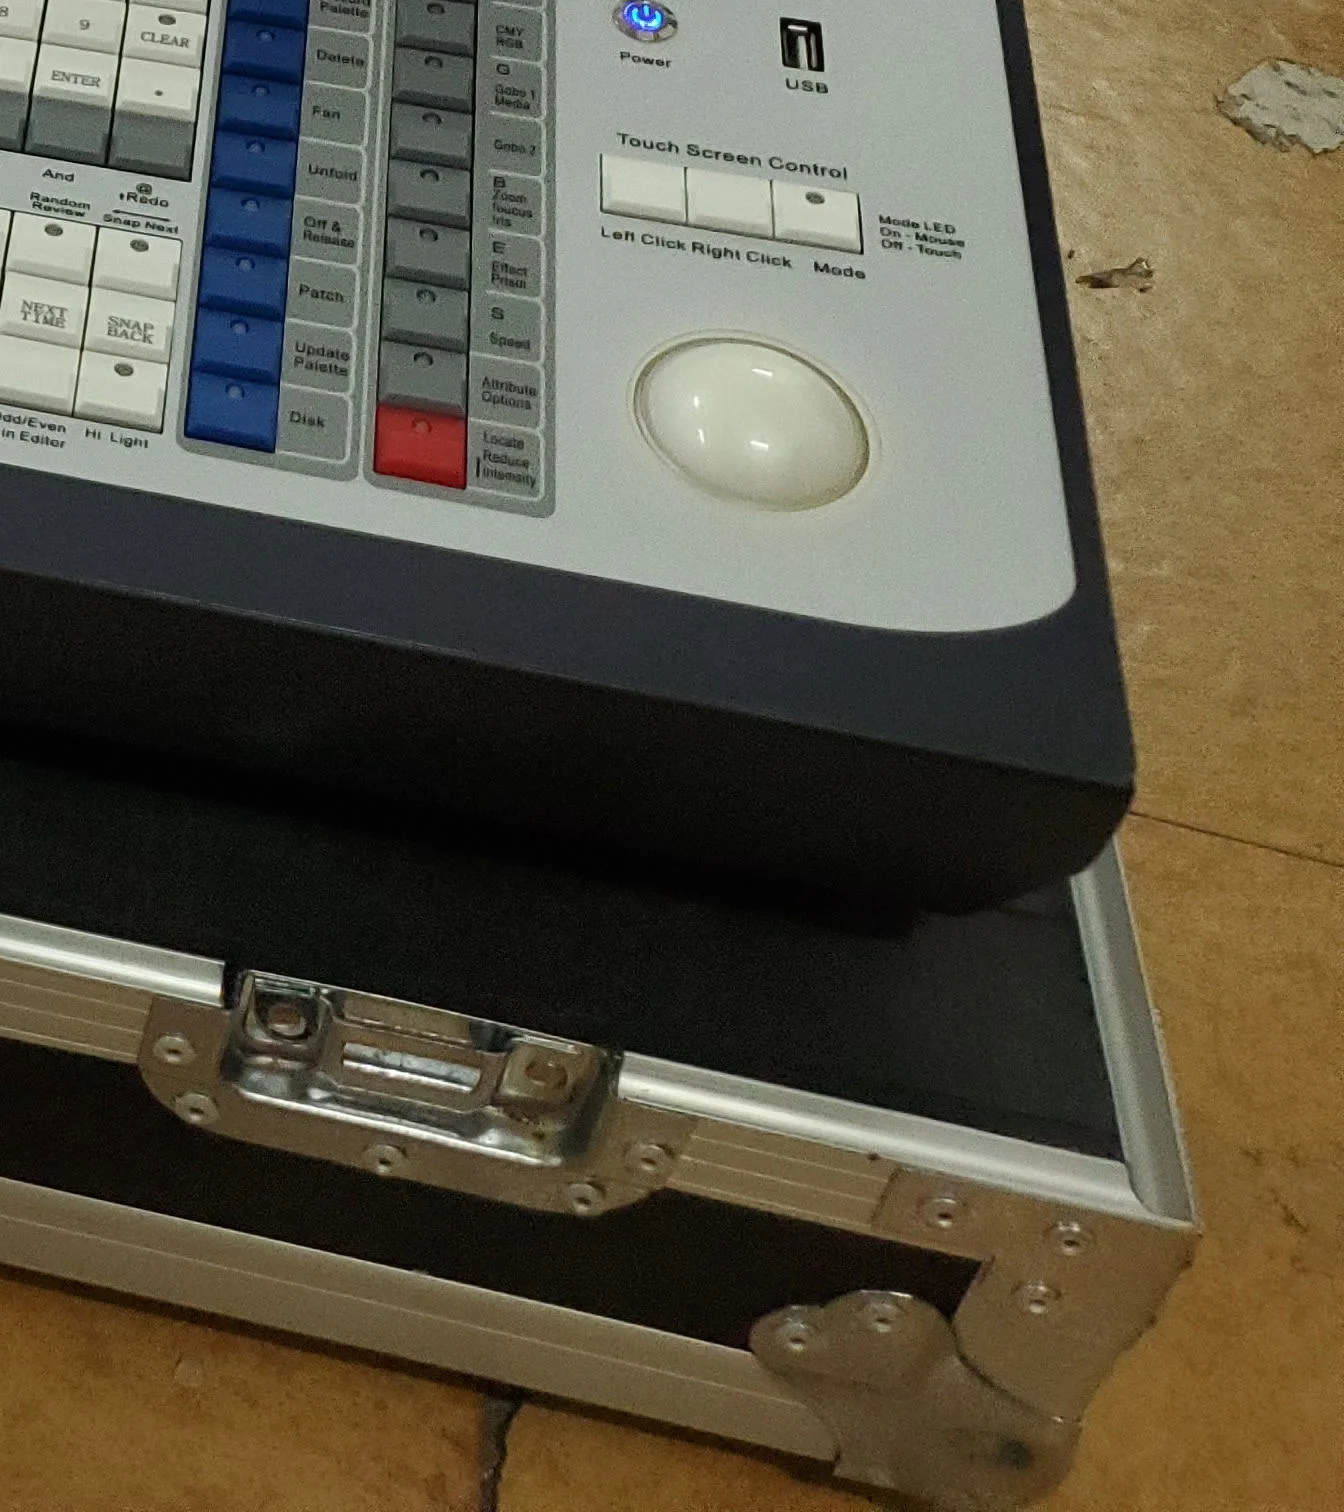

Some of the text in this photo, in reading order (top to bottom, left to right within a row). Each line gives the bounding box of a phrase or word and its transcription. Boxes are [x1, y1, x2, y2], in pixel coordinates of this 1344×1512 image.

[320, 2, 368, 16] Palette
[79, 19, 90, 31] 9
[141, 31, 189, 49] CLEAR
[317, 50, 364, 67] Delete
[620, 52, 671, 68] Power
[51, 71, 101, 88] ENTER
[786, 78, 828, 93] USB
[313, 107, 340, 120] Fan
[617, 133, 847, 179] Touch Screen Control
[42, 168, 75, 182] And
[309, 164, 357, 181] Unfold
[30, 192, 90, 211] Random
[32, 202, 85, 218] Review
[103, 213, 178, 234] Snap Next
[304, 217, 326, 230] Off
[879, 215, 955, 234] Mode LED
[303, 230, 354, 248] Release
[880, 227, 965, 248] On Mouse
[601, 226, 792, 268] Left Click Right Click
[916, 244, 961, 259] Touch
[814, 261, 865, 279] Mode
[299, 284, 344, 303] Patch
[22, 300, 68, 317] NEXT
[21, 310, 65, 328] TIME
[108, 316, 154, 334] SNAP
[107, 327, 153, 344] BACK
[489, 332, 530, 351] Speed
[295, 341, 350, 361] Update
[294, 356, 349, 376] Palette
[482, 377, 536, 397] Attribute
[482, 392, 531, 410] Options
[290, 411, 325, 427] Disk
[2, 431, 15, 440] in
[19, 433, 65, 449] Editor
[85, 428, 149, 450] Hi Light
